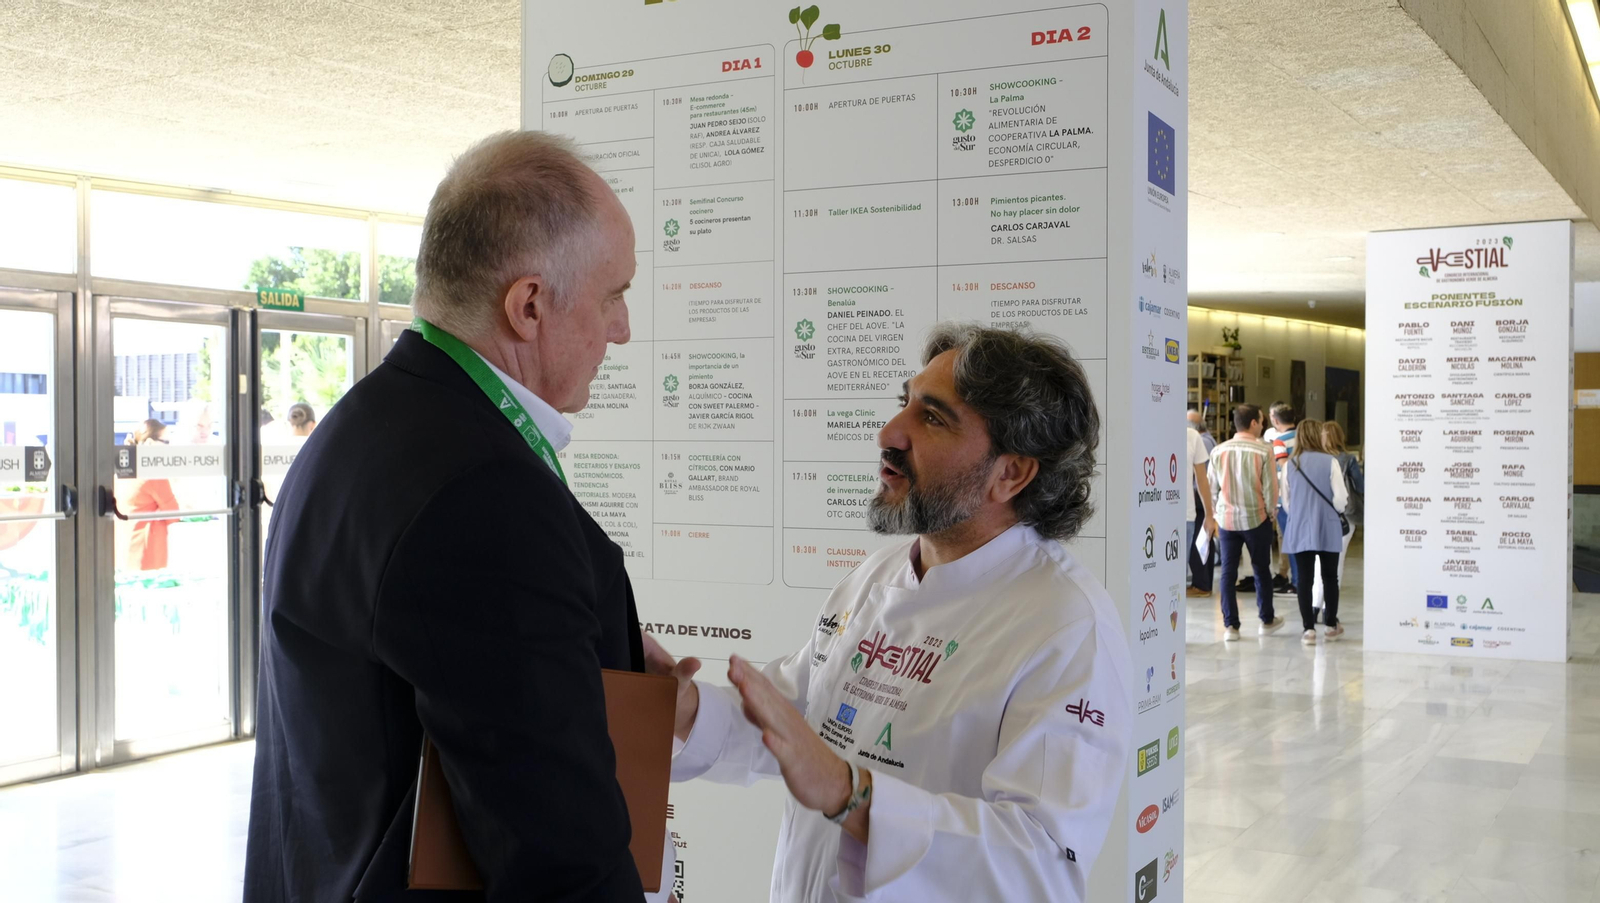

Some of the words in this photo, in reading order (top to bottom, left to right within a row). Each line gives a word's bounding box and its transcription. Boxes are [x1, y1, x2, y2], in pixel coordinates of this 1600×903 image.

[1031, 28, 1073, 46] DIA
[1077, 26, 1091, 40] 2
[829, 47, 871, 59] LUNES
[874, 44, 891, 54] 30
[722, 59, 751, 72] DIA
[754, 58, 761, 69] 1
[829, 58, 872, 70] OCTUBRE
[575, 71, 620, 83] DOMINGO
[622, 69, 634, 78] 29
[575, 81, 607, 92] OCTUBRE
[951, 87, 977, 97] 10:30H
[990, 78, 1057, 90] SHOWCOOKING
[795, 103, 818, 112] 10:00H
[829, 99, 867, 109] APERTURA
[870, 97, 879, 105] DE
[882, 94, 916, 104] PUERTAS
[1001, 94, 1024, 102] Palma
[690, 122, 706, 130] JUAN
[707, 120, 727, 128] PEDRO
[729, 118, 746, 126] SEIJO
[989, 118, 1044, 129] ALIMENTARIA
[706, 129, 730, 138] ANDREA
[732, 127, 760, 135] ÁLVAREZ
[989, 131, 1047, 142] COOPERATIVA
[953, 134, 975, 143] gusto
[740, 147, 764, 155] GÓMEZ
[989, 143, 1034, 155] ECONOMÍA
[1036, 141, 1080, 151] CIRCULAR,
[989, 156, 1043, 167] DESPERDICIO
[953, 197, 979, 207] 13:00H
[991, 196, 1029, 205] Pimientos
[794, 209, 818, 218] 11:30H
[828, 209, 848, 217] Taller
[850, 206, 868, 215] IKEA
[870, 203, 921, 213] Sostenibilidad
[991, 210, 999, 218] No
[1002, 209, 1017, 218] hay
[1019, 209, 1044, 217] placer
[1046, 206, 1057, 214] sin
[695, 217, 721, 225] cocineros
[723, 216, 751, 224] presentan
[991, 223, 1024, 232] CARLOS
[1026, 220, 1070, 230] CARJAVAL
[697, 228, 712, 236] plato
[991, 237, 1004, 245] DR.
[1007, 235, 1037, 244] SALSAS
[793, 288, 817, 296] 13:30H
[828, 285, 888, 294] SHOWCOOKING
[990, 282, 1036, 291] DESCANSO
[260, 292, 299, 308] SALIDA
[1432, 292, 1496, 301] PONENTES
[1405, 301, 1473, 309] ESCENARIO
[1475, 298, 1523, 307] FUSIÓN
[856, 346, 900, 354] RECORRIDO
[827, 358, 889, 367] GASTRONÓMICO
[873, 370, 916, 378] RECETARIO
[142, 456, 186, 467] EMPUJEN
[194, 456, 219, 466] PUSH
[793, 546, 817, 554] 18:30H
[827, 548, 866, 556] CLAUSURA
[678, 625, 698, 636] DE
[700, 627, 752, 640] VINOS
